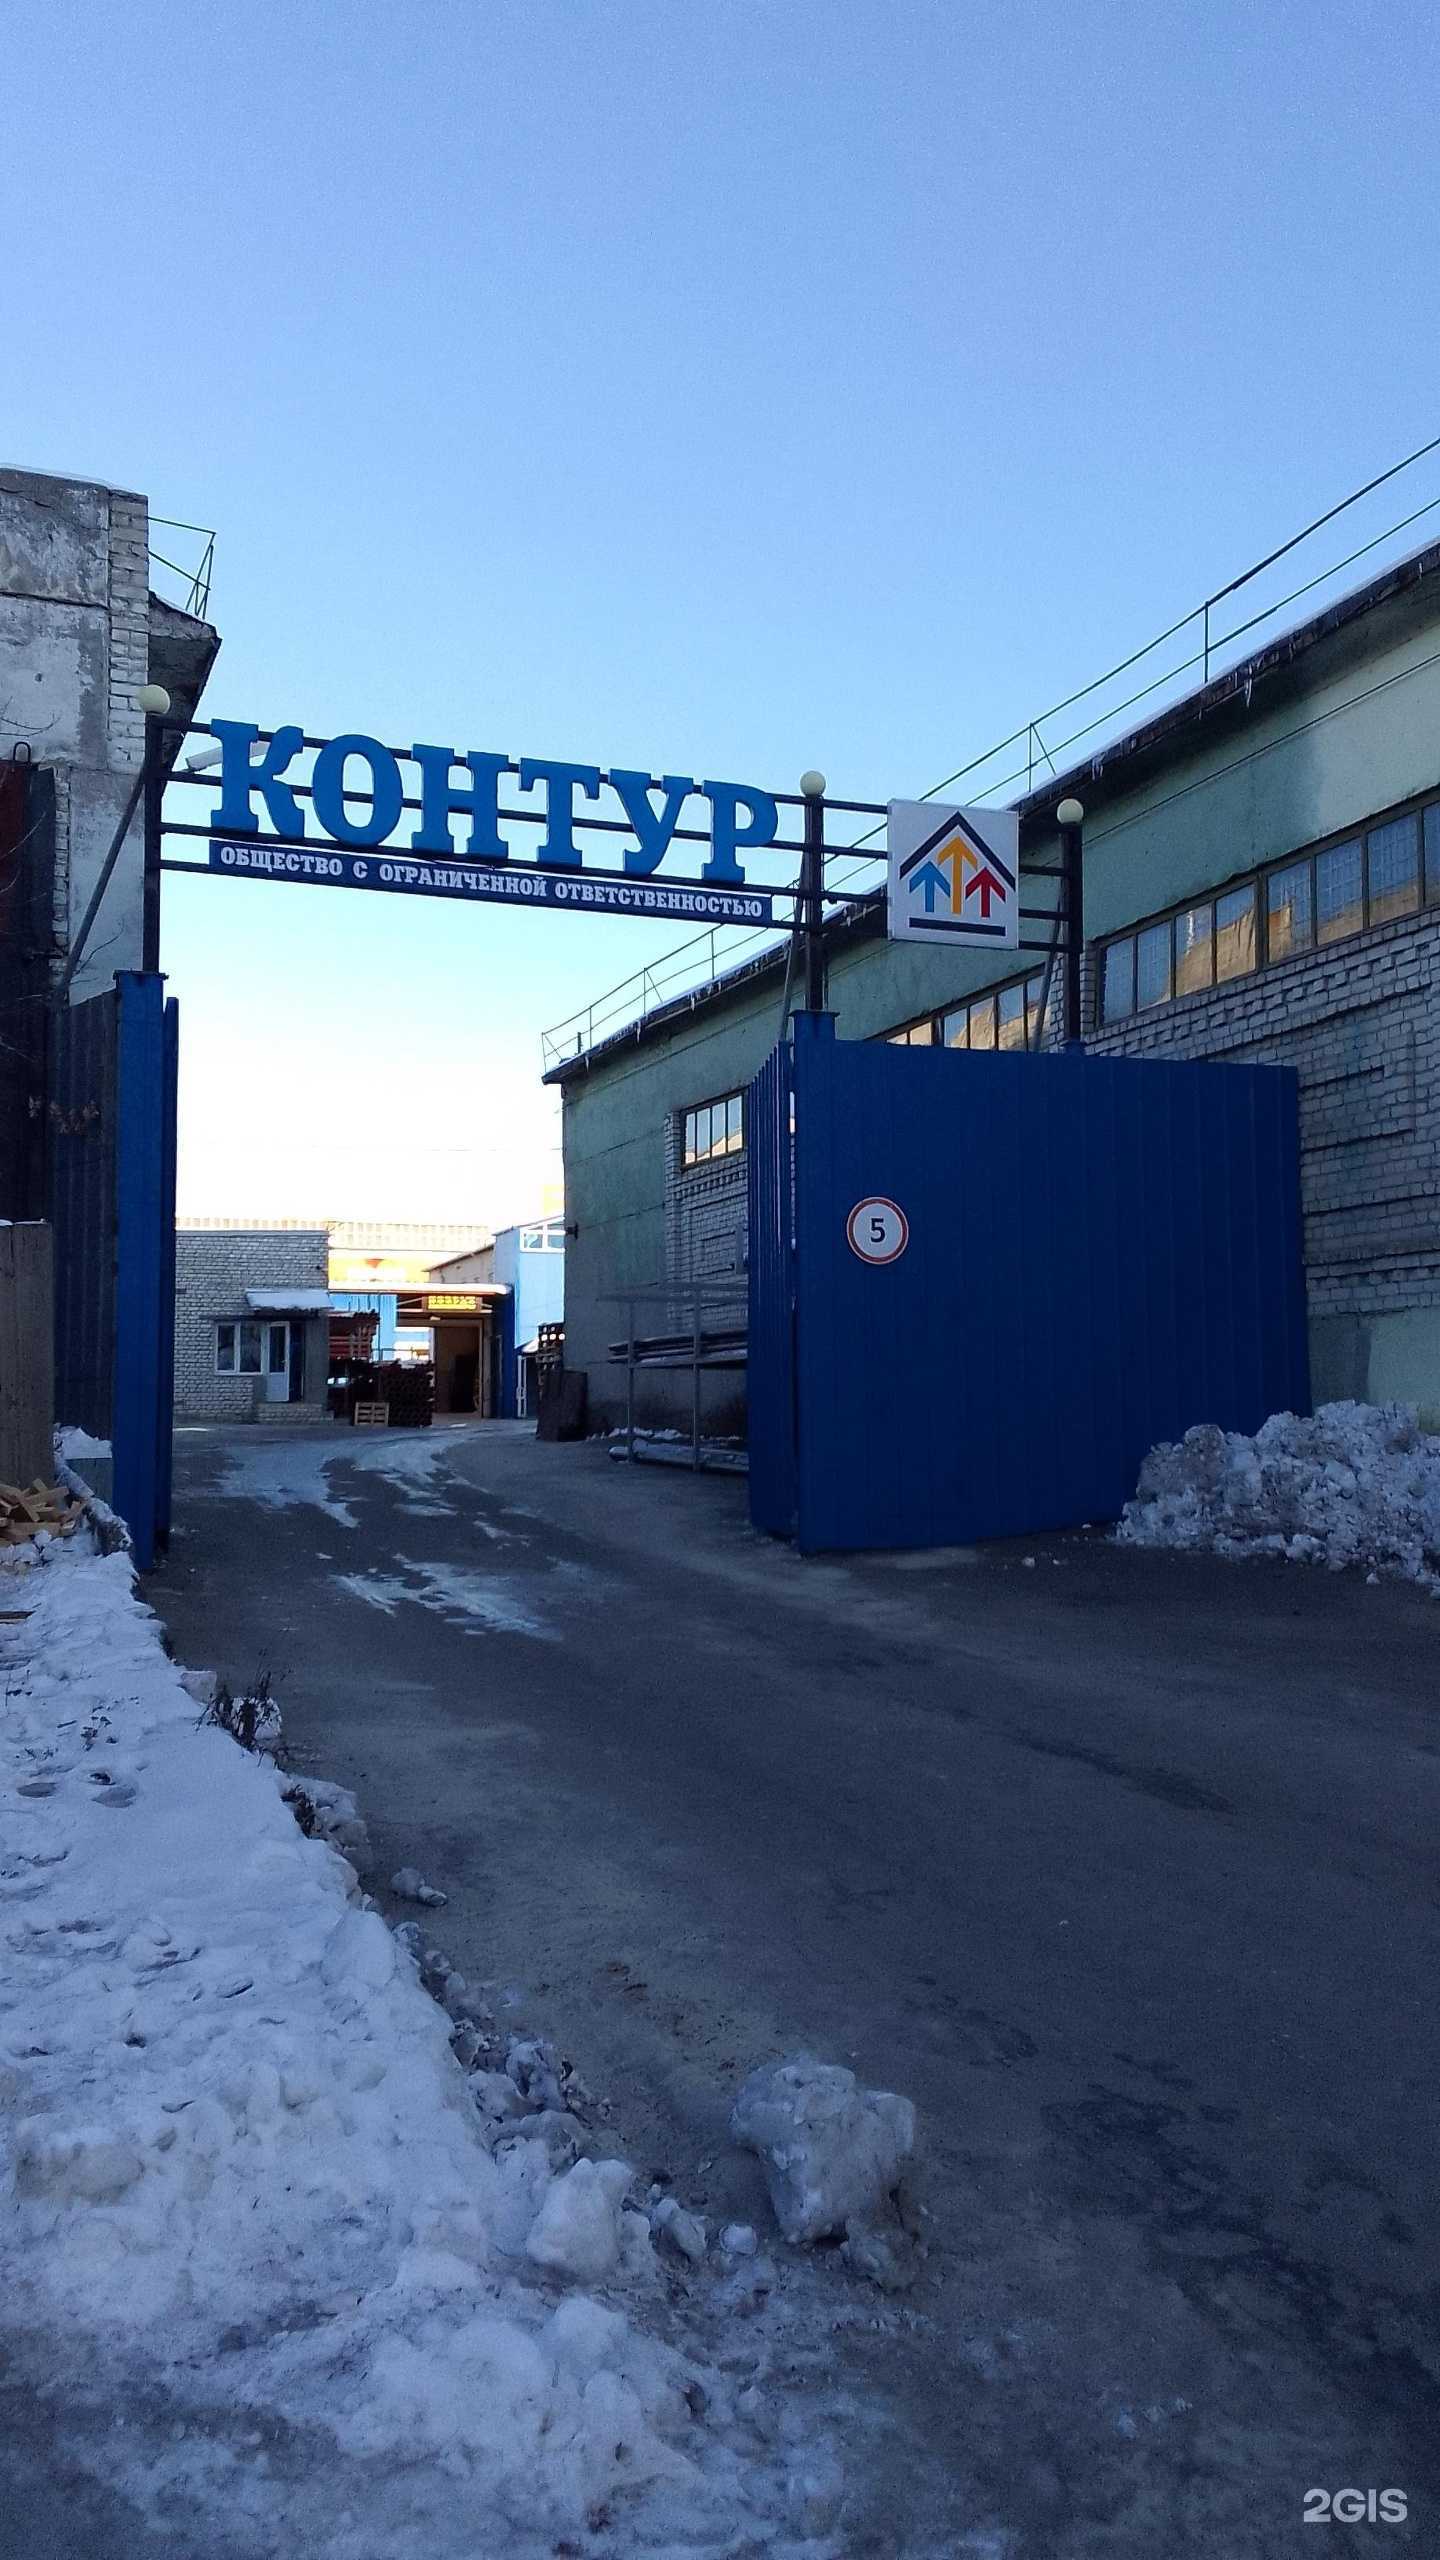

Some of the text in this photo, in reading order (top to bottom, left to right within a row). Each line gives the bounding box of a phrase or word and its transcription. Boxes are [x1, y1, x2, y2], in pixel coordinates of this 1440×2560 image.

[211, 719, 778, 883] КОНТУР
[219, 846, 762, 917] ОБЩЕСТВО С ОГРАНИЧЕННОЙ ОТВЕТСТВЕННОСТЬЮ
[870, 1218, 886, 1243] 5
